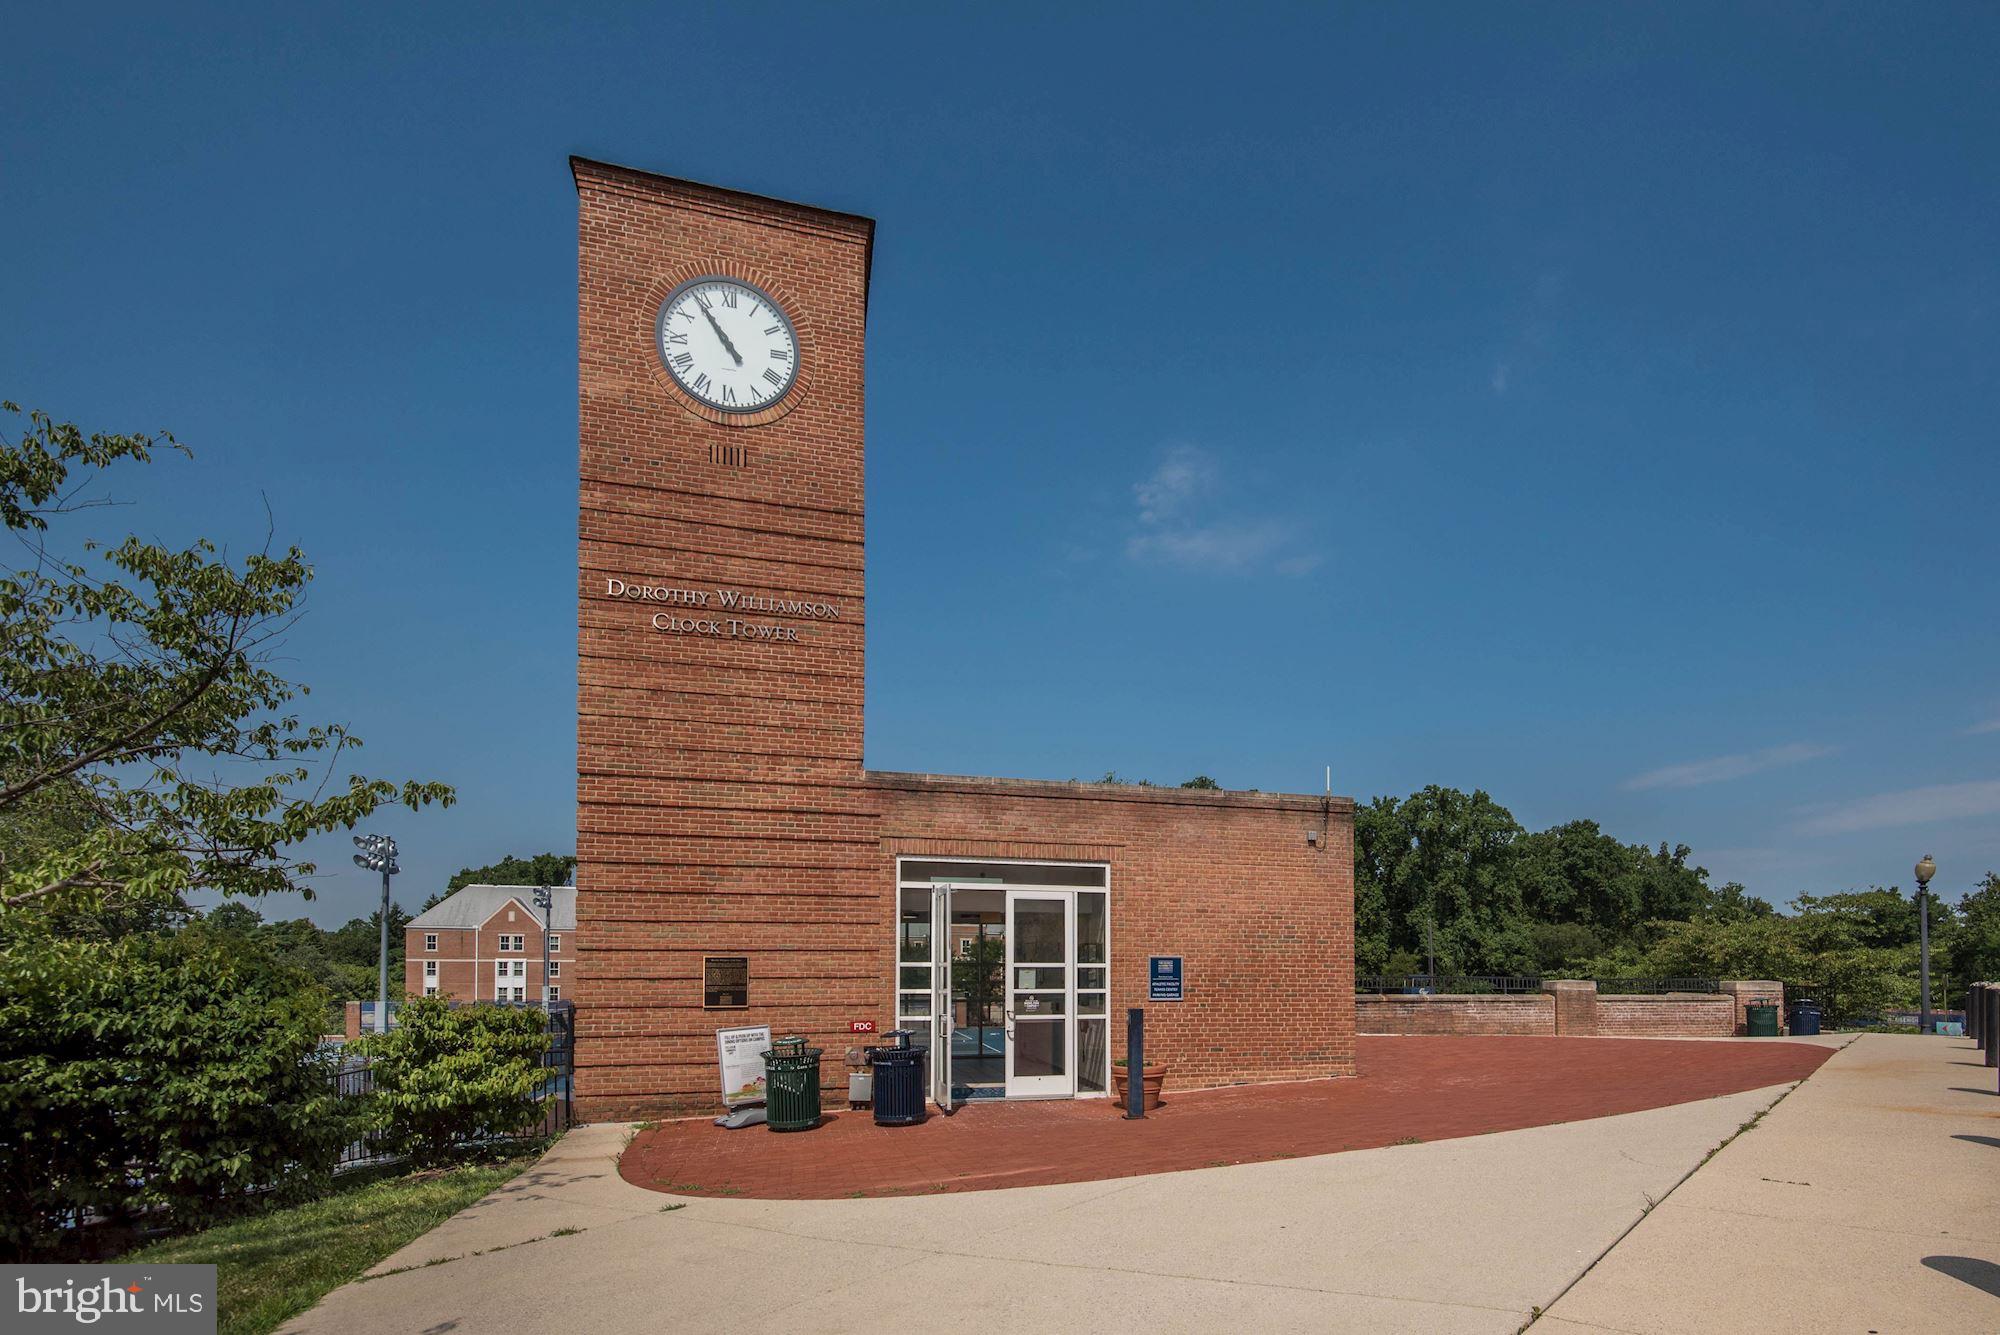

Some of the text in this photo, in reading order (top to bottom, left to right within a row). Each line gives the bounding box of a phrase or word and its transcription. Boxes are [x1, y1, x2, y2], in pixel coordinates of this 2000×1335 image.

[607, 578, 841, 619] DOROTHY WILLIAMSON
[652, 612, 799, 642] CLOCK TOWER
[853, 1022, 872, 1031] FDC
